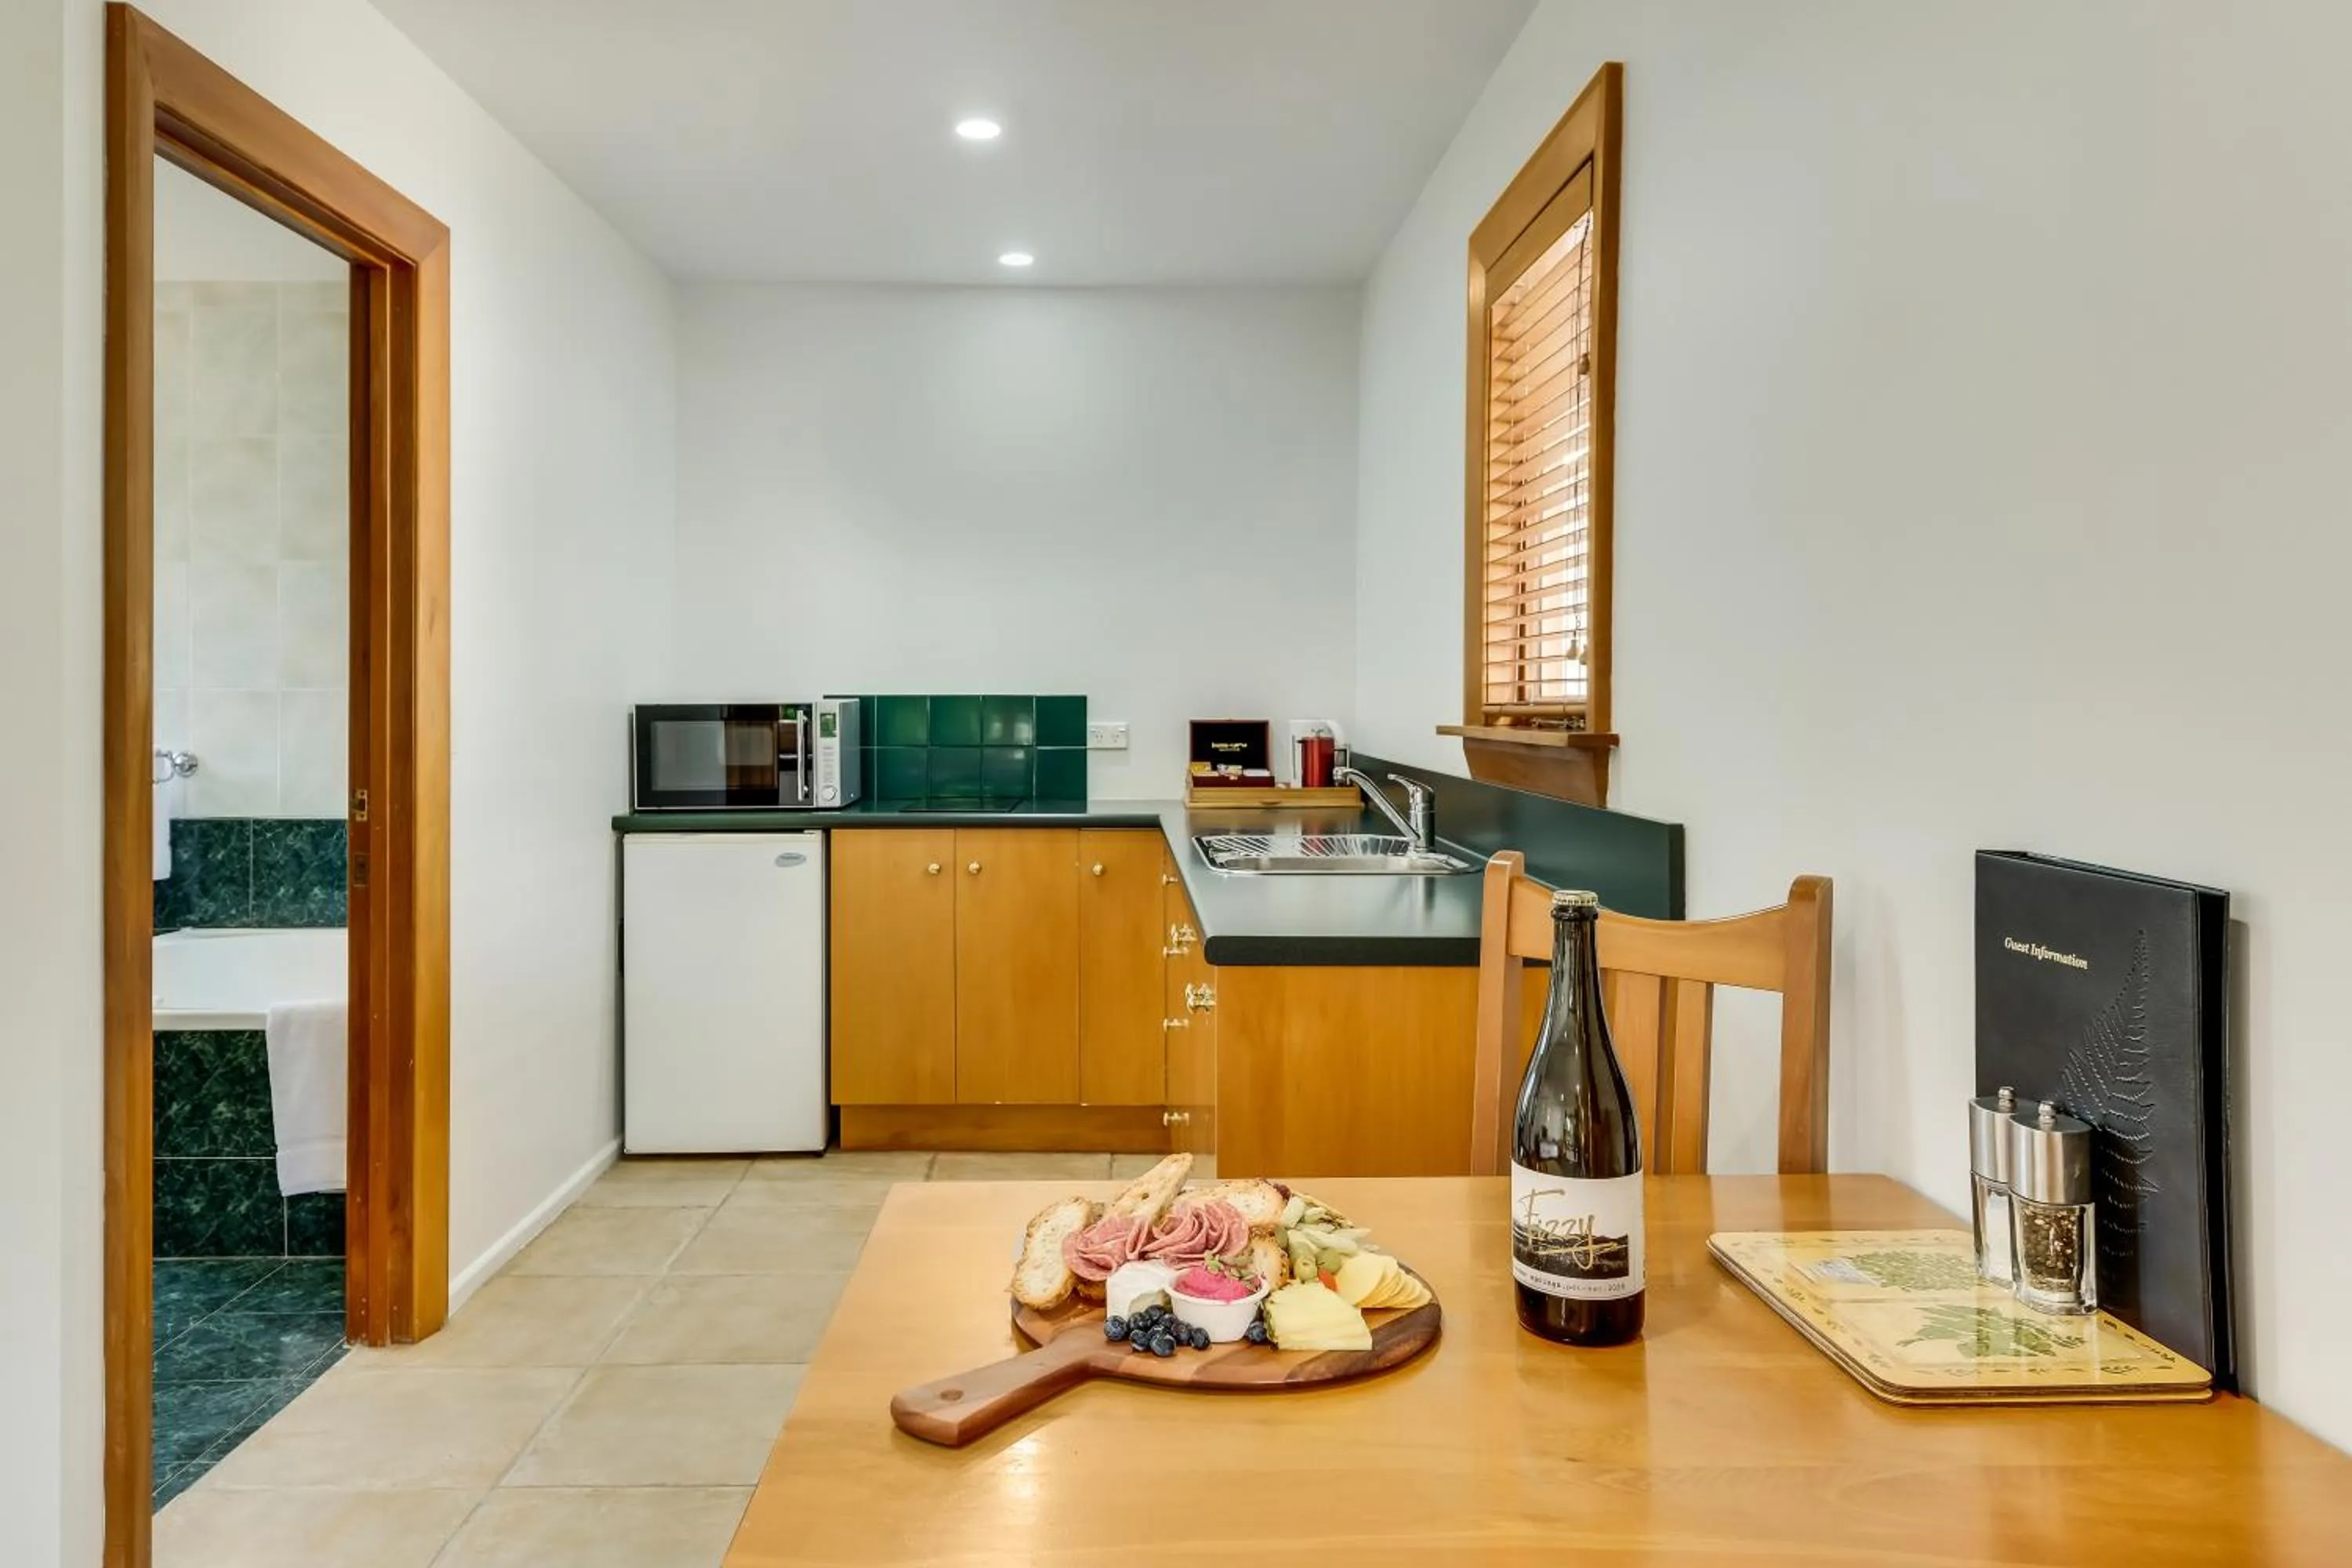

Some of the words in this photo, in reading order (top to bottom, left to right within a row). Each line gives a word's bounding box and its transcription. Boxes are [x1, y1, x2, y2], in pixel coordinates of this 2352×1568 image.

[2004, 937, 2030, 954] Guest
[2031, 943, 2089, 970] Information
[1518, 1188, 1596, 1270] Fizzy
